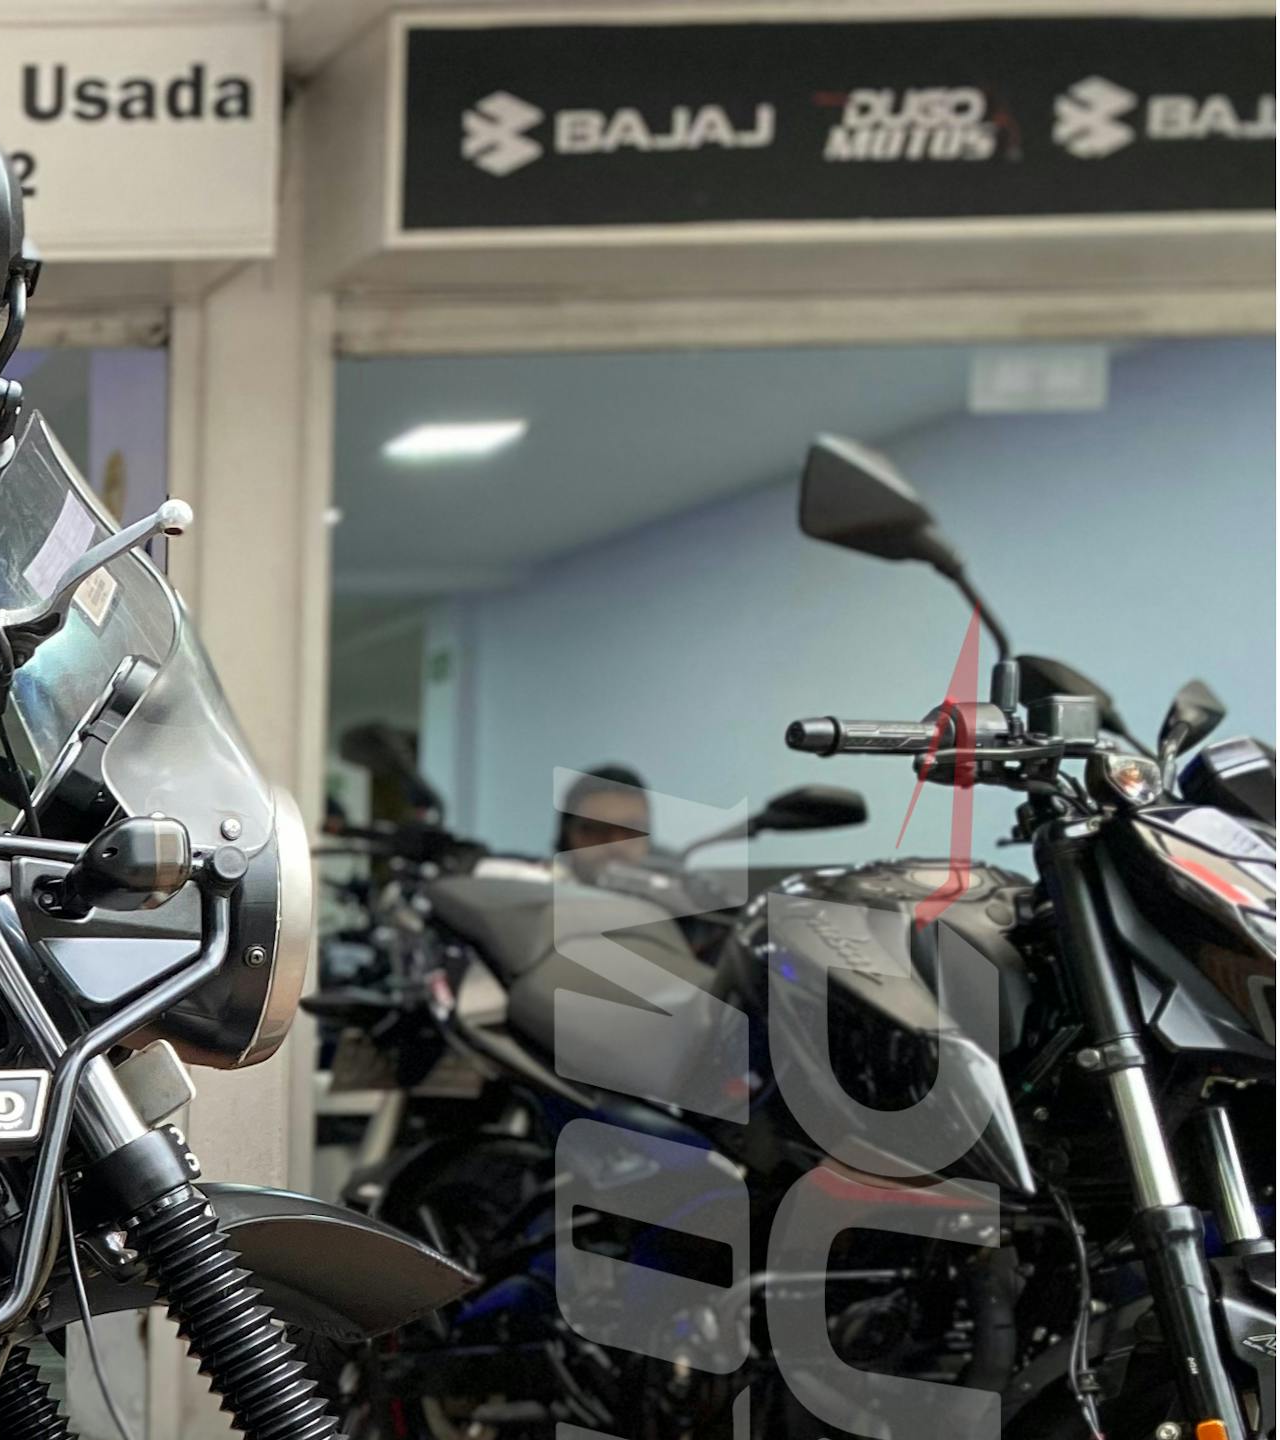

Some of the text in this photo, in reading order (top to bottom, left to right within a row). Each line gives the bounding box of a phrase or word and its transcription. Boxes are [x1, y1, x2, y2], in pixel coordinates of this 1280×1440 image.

[20, 62, 254, 123] Usada
[844, 87, 987, 130] DUGO
[553, 103, 775, 154] BAJAJ
[823, 124, 998, 163] MOTOS
